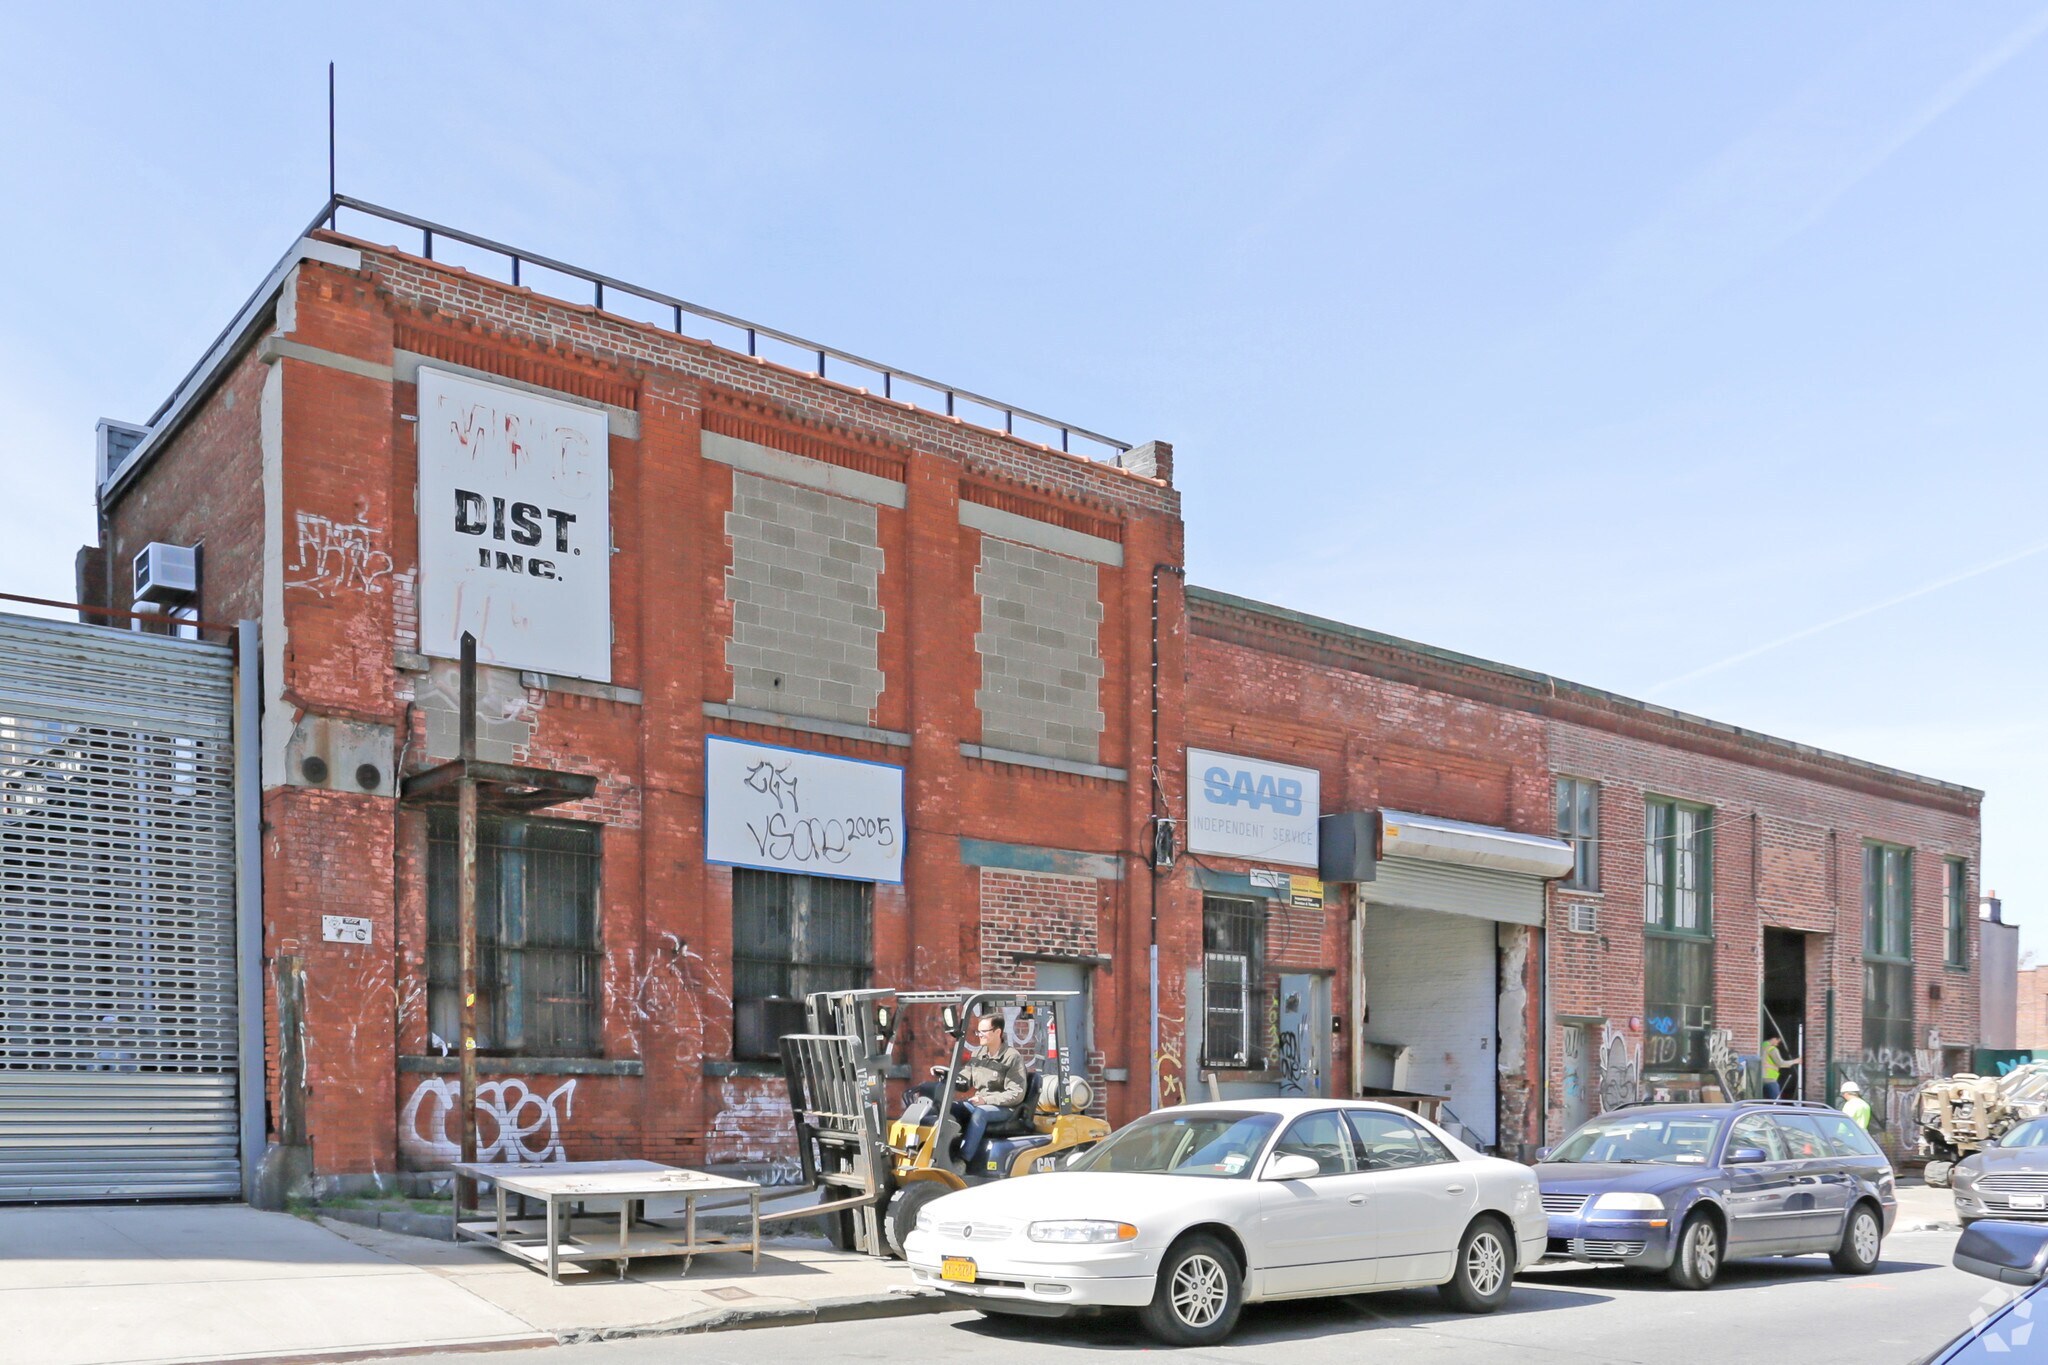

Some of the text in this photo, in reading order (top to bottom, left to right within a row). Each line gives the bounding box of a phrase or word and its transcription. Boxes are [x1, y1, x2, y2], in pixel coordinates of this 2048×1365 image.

[455, 488, 581, 556] DIST.
[478, 548, 563, 582] INC.
[1203, 766, 1303, 817] SAAB
[845, 816, 894, 846] 2005
[1193, 815, 1265, 839] INDEPENDENT
[1272, 827, 1313, 846] SERVICE
[1036, 1156, 1056, 1173] CAT
